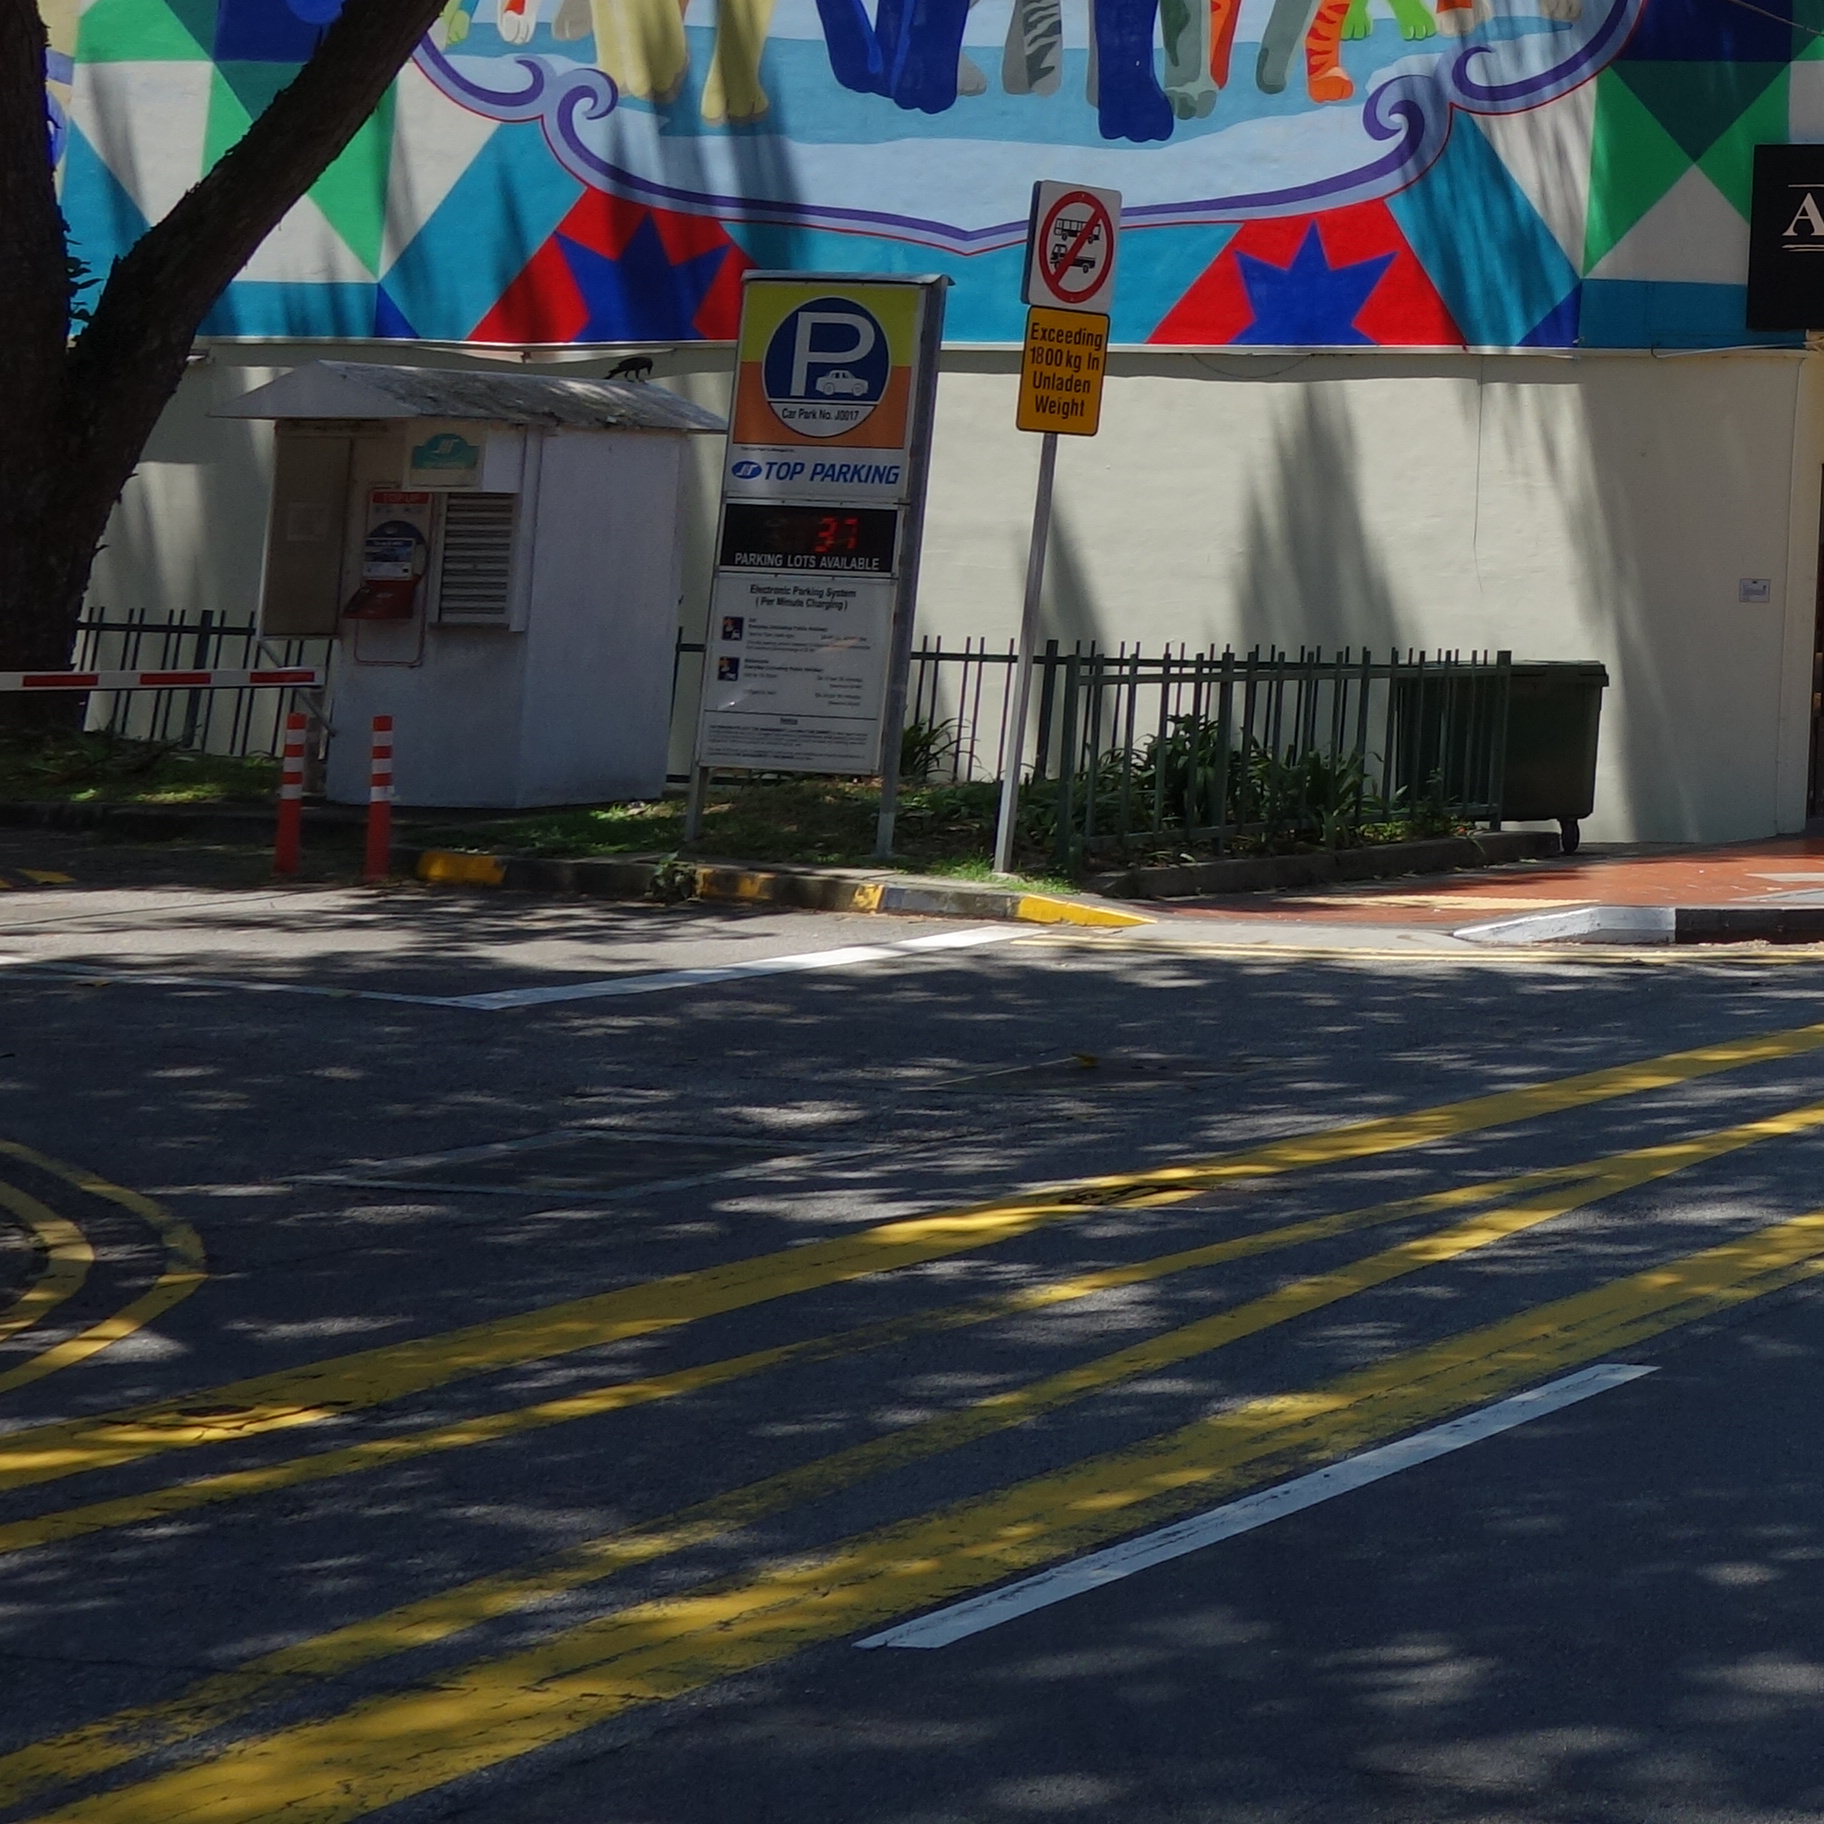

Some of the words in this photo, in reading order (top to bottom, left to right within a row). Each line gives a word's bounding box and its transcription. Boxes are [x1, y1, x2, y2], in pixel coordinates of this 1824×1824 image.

[1031, 323, 1103, 351] Exceeding
[790, 311, 876, 396] P
[1030, 346, 1063, 367] 1800
[1066, 350, 1081, 373] kg
[1087, 353, 1099, 370] In
[1033, 371, 1091, 394] Unladen
[782, 407, 796, 420] Car
[798, 408, 817, 420] Park
[819, 409, 833, 421] No.
[1035, 395, 1085, 420] Weight
[764, 461, 805, 481] TOP
[809, 463, 900, 485] PARKING
[735, 552, 783, 567] PARKING
[787, 555, 816, 568] LOTS
[820, 556, 880, 571] AVAILABLE
[750, 584, 791, 595] Electronic
[792, 586, 825, 598] Parking
[826, 588, 856, 601] System
